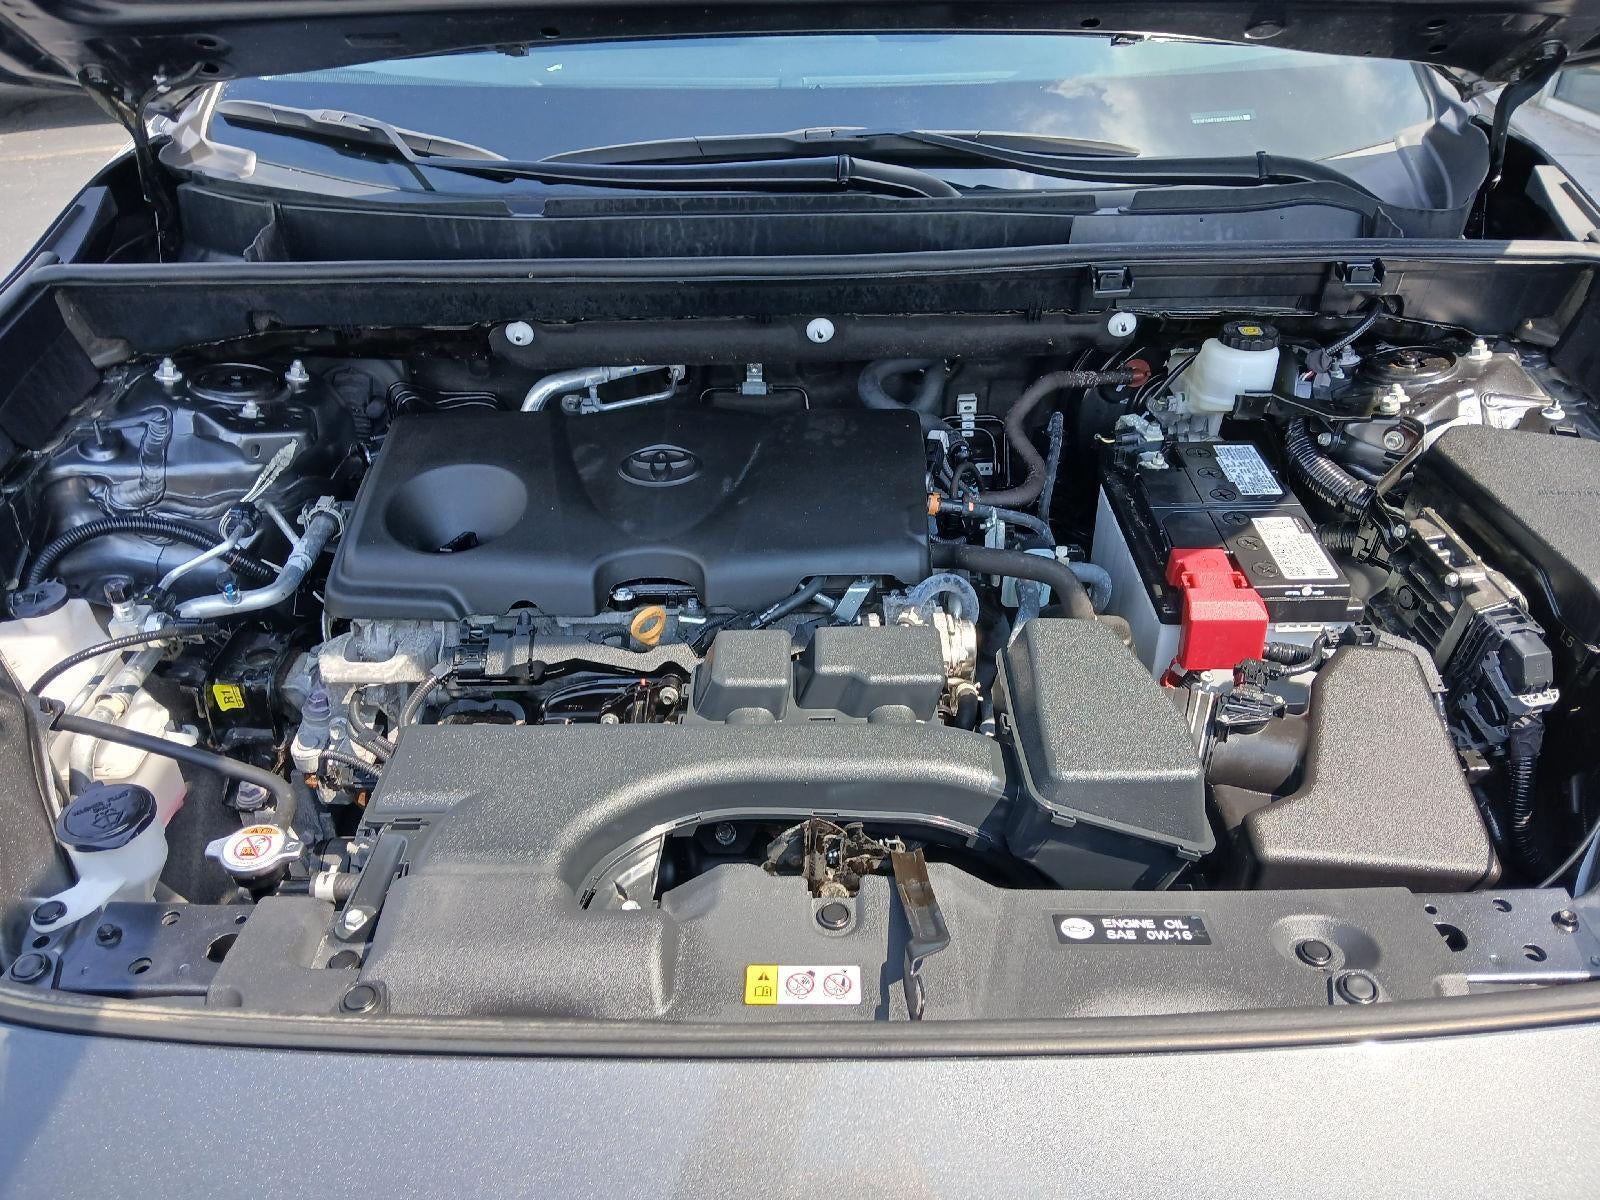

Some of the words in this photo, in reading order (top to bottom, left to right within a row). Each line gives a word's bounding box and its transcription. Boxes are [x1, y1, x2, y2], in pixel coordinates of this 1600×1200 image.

[1101, 918, 1156, 929] ENGINE
[1163, 919, 1189, 930] OIL
[1106, 929, 1137, 940] SAE
[1146, 930, 1193, 941] 0W-16
